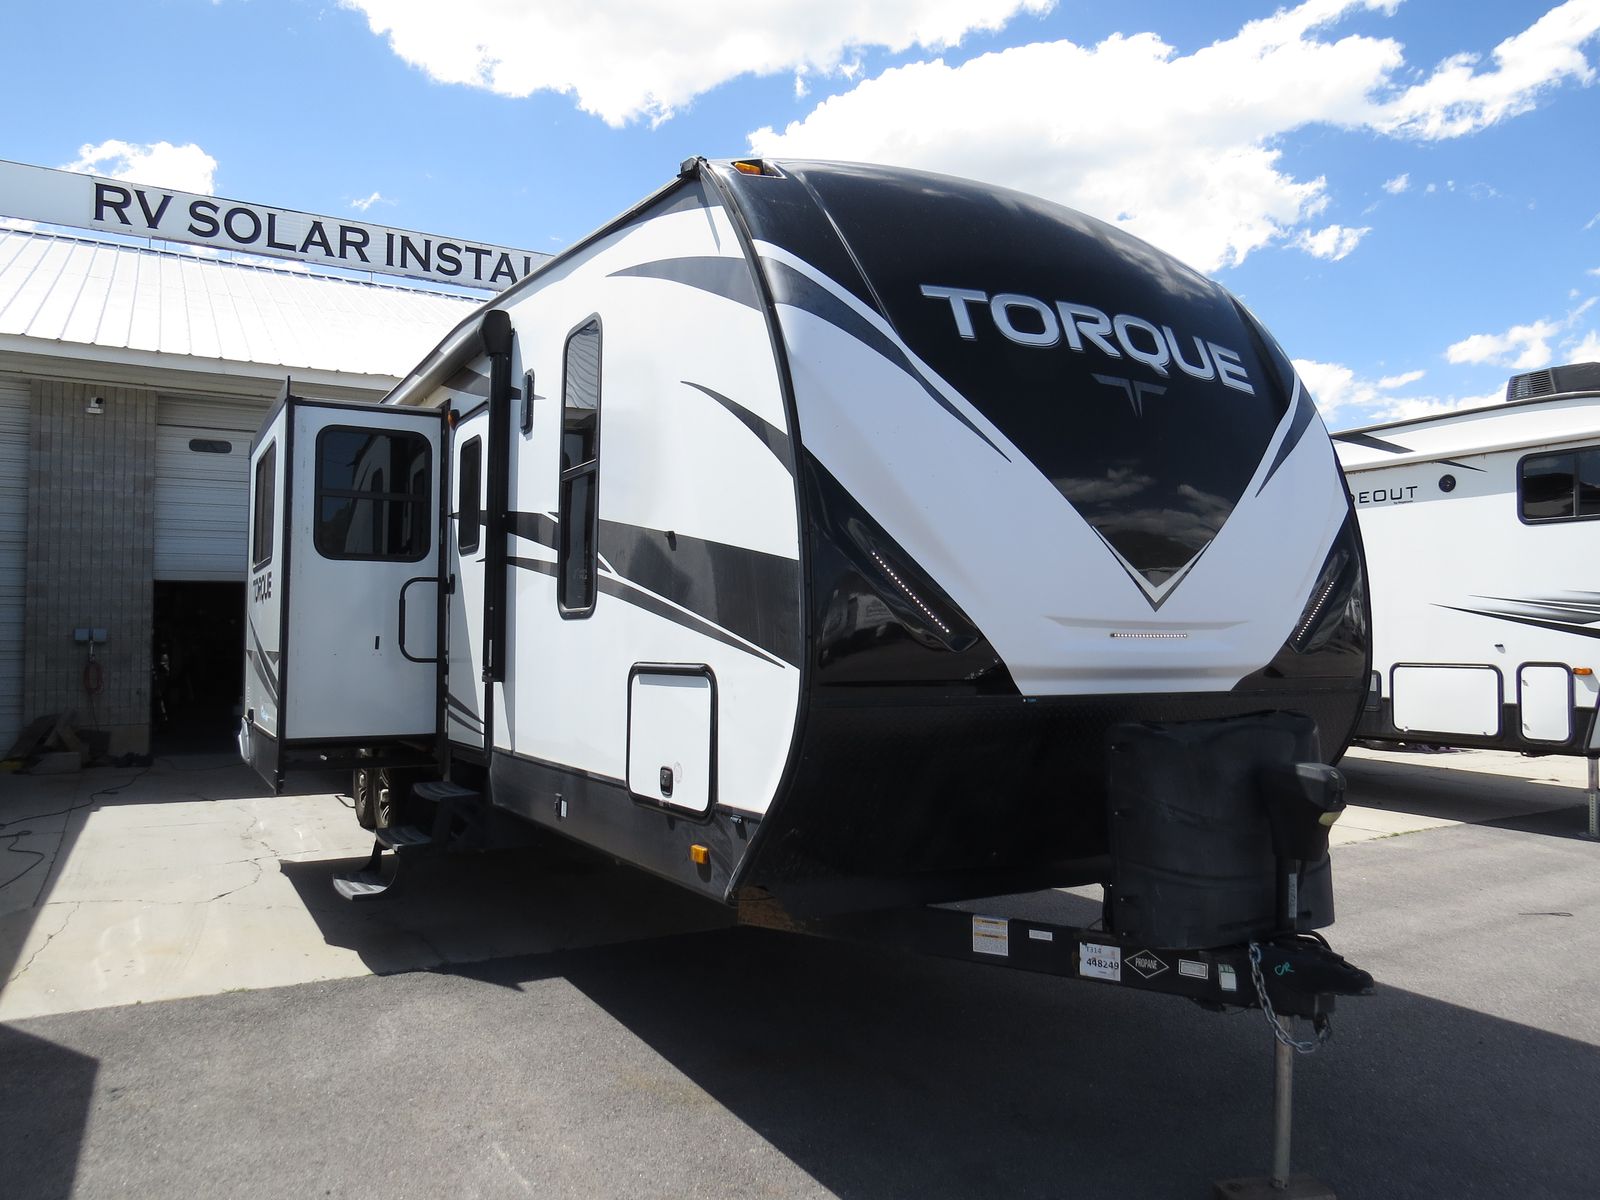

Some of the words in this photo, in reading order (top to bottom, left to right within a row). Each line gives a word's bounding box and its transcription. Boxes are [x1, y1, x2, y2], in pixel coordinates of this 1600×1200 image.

[93, 182, 172, 229] RV
[187, 200, 371, 263] SOLAR
[919, 284, 1255, 395] TORQUE
[1086, 958, 1120, 970] 448249
[1135, 957, 1158, 970] PROPANE
